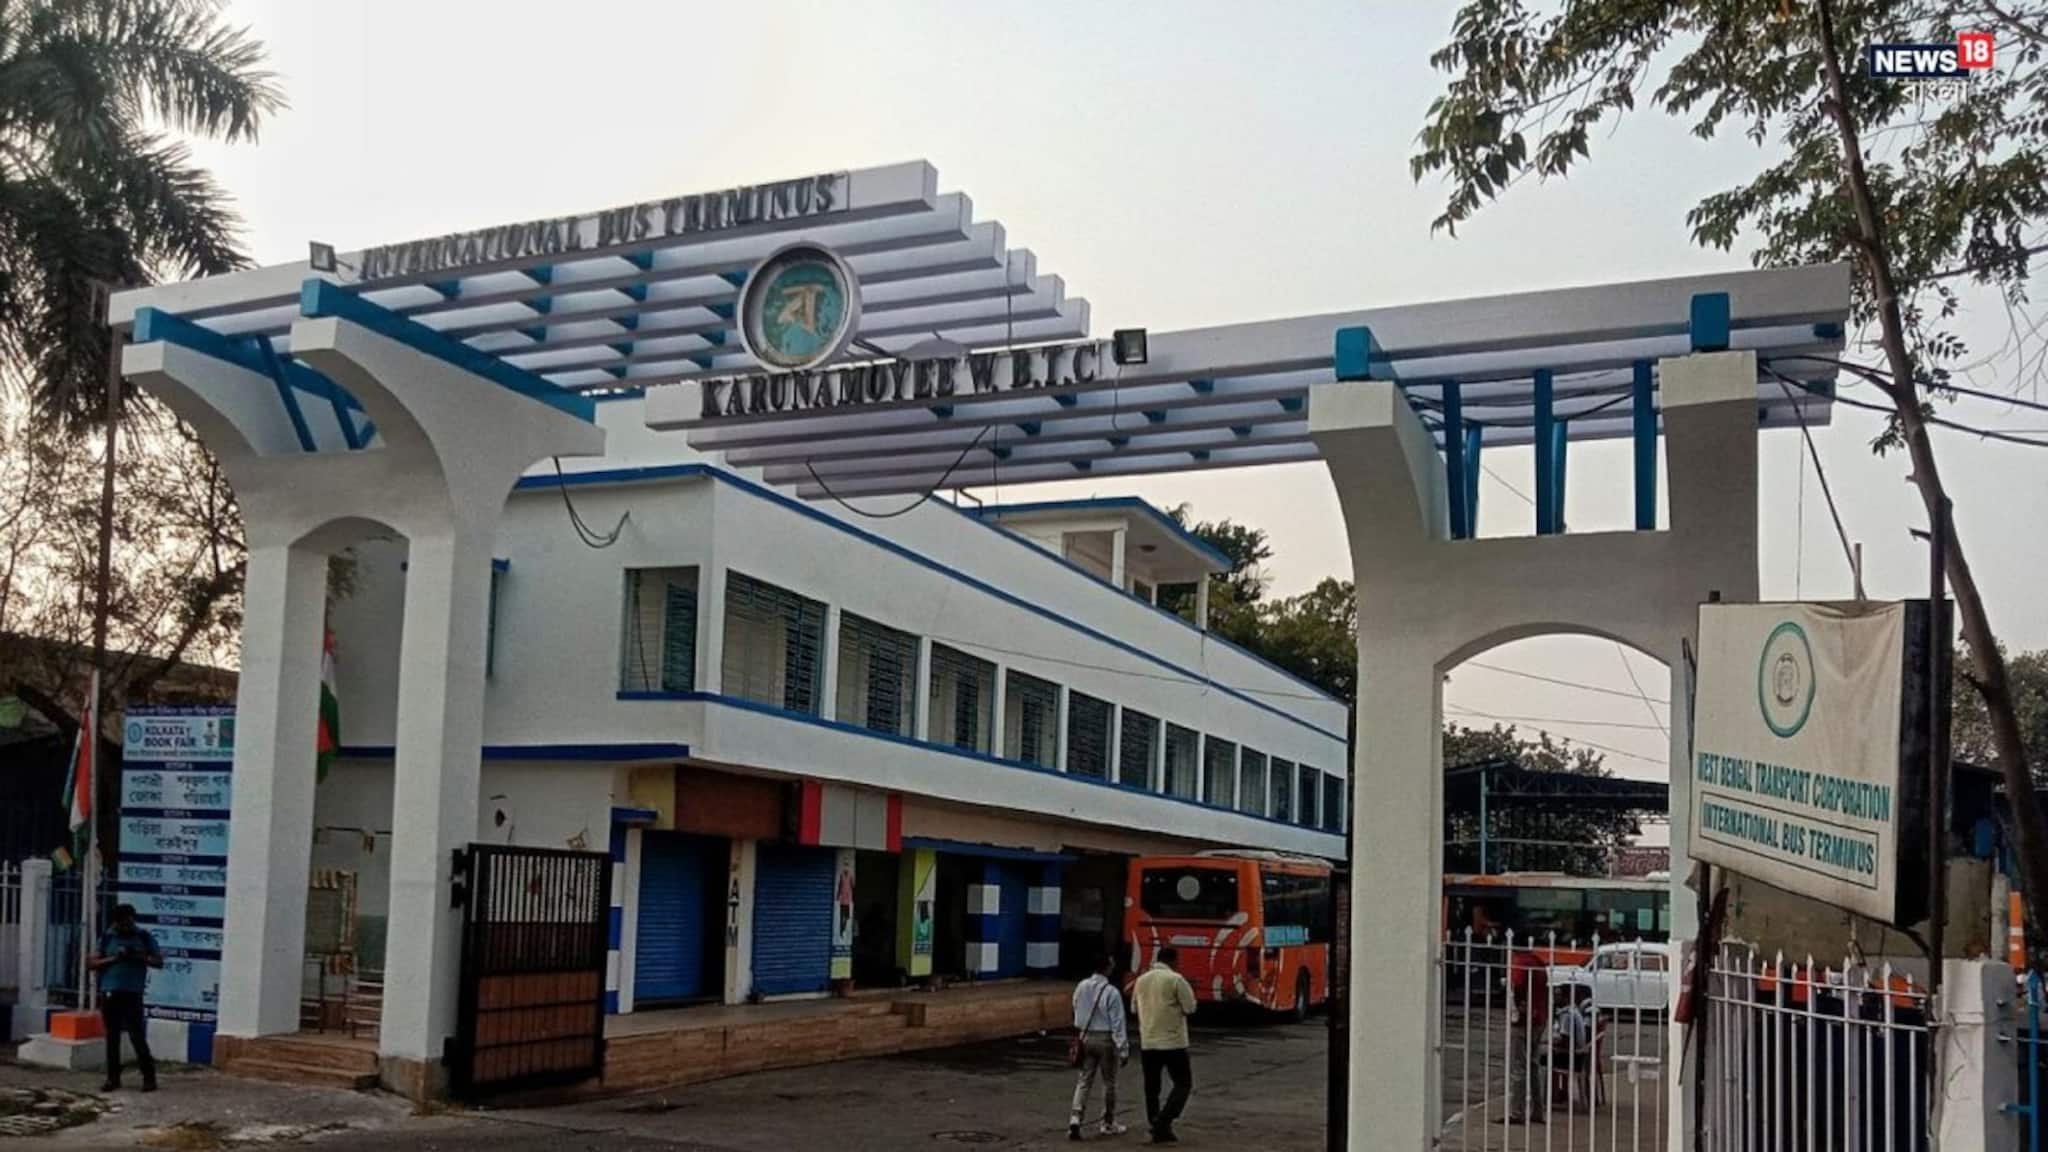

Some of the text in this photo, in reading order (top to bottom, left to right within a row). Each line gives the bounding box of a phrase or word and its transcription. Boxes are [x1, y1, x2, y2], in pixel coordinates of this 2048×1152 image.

[359, 174, 836, 280] INTERNATIONAL BUS TERMINUS
[702, 358, 956, 418] KARUNAMOYEE
[144, 737, 197, 748] BOOK FAIR
[145, 726, 184, 737] KOLKATA
[1697, 752, 1890, 823] WEST BENGAL TRANSPORT CORPORATION
[1703, 803, 1875, 875] INTERNATIONAL BUS TERMINUS
[726, 878, 740, 946] ATM
